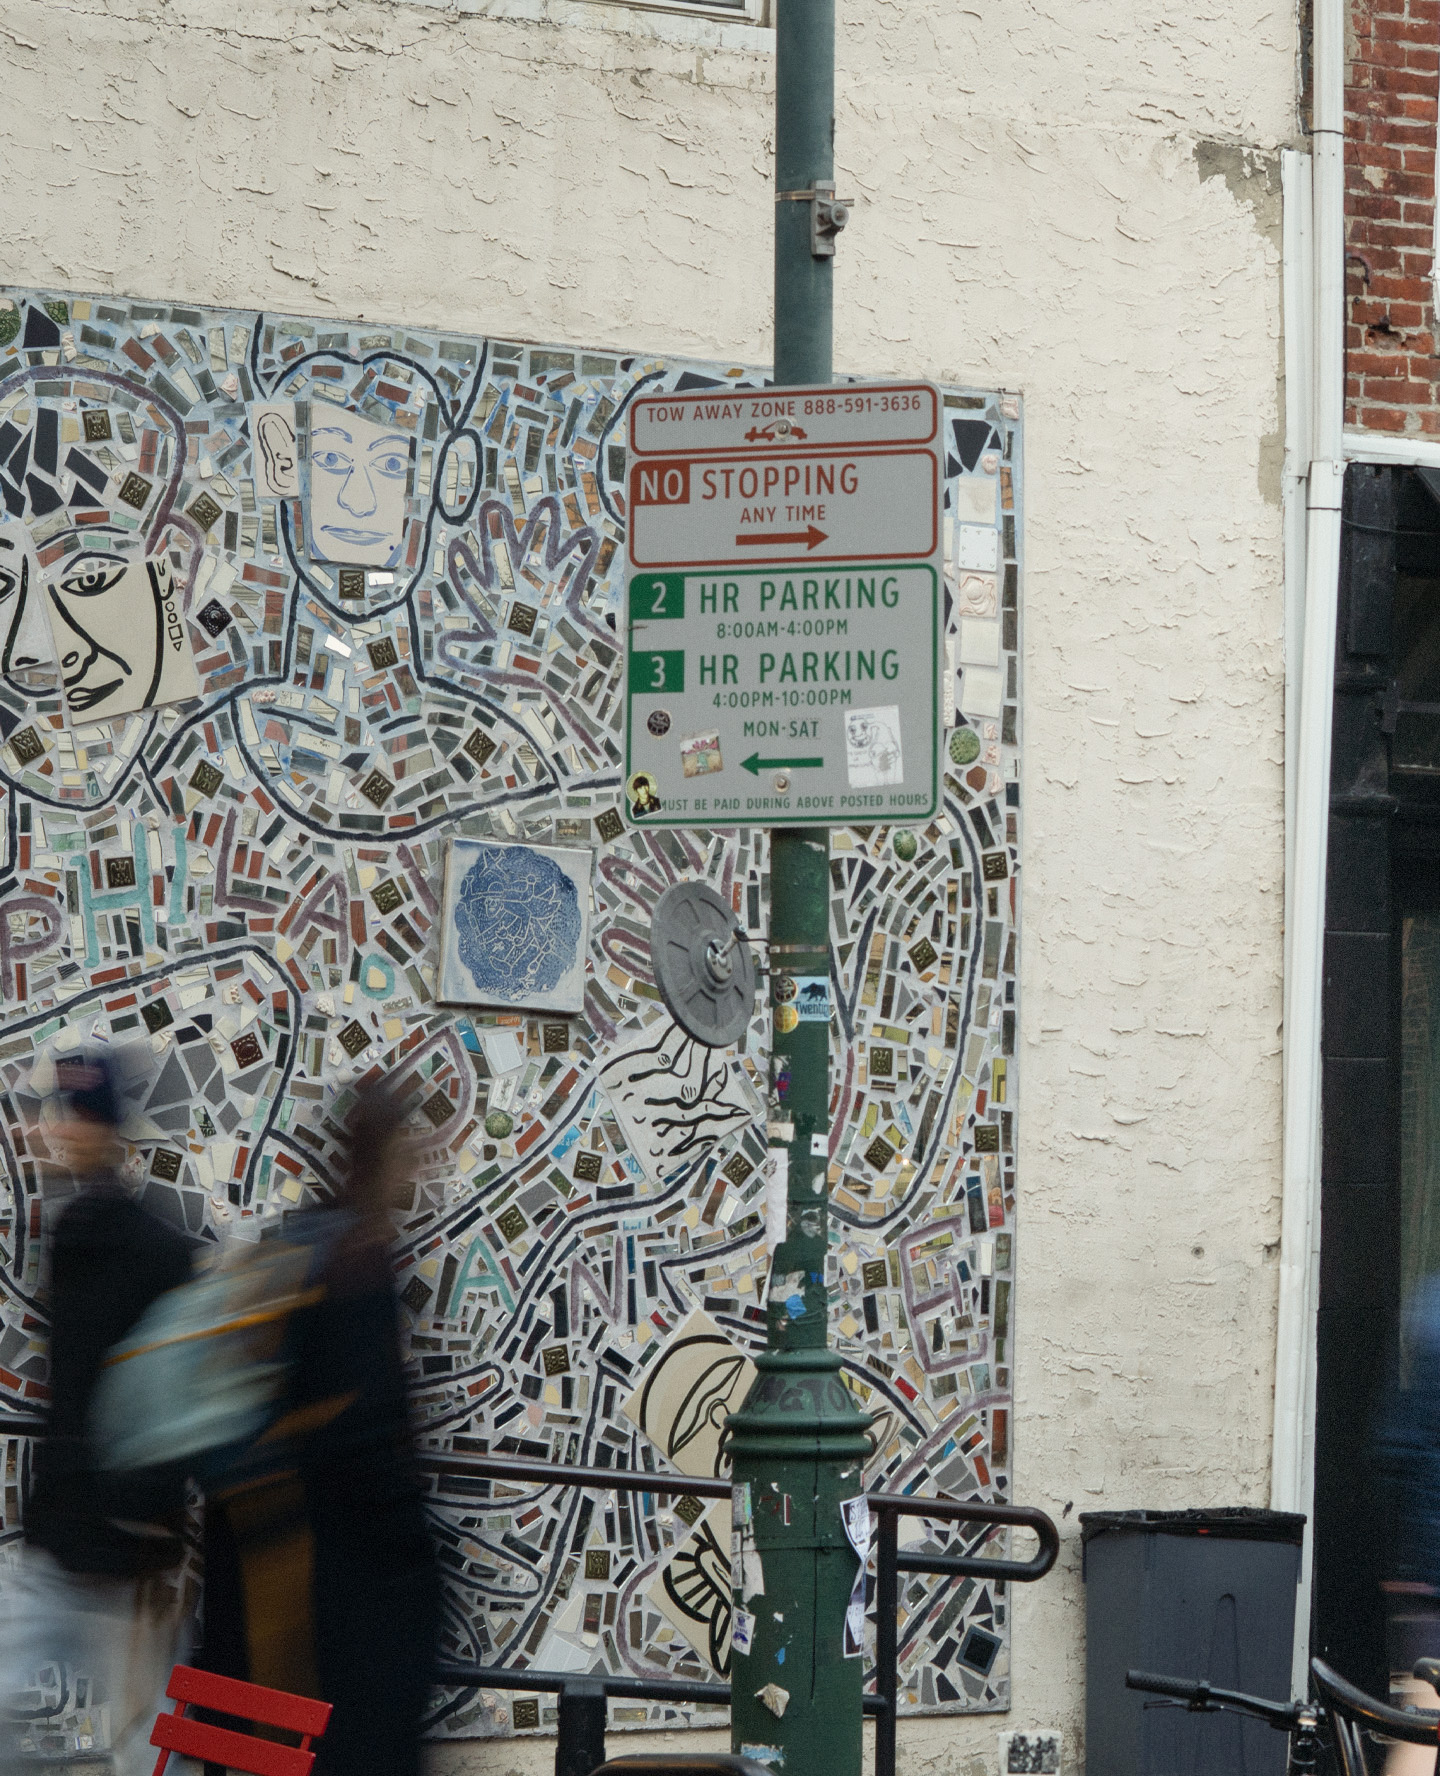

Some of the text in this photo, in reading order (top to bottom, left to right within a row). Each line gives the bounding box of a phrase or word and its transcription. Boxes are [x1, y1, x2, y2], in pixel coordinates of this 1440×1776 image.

[647, 395, 921, 423] TOW AWAY ZONE 888-591-3636
[639, 463, 859, 500] NO STOPPING
[740, 504, 826, 523] ANY TIME
[650, 576, 900, 614] 2 HR PARKING
[716, 619, 848, 639] 8:00AM-4:00PM
[650, 648, 899, 688] 3 HR PARKING
[712, 689, 852, 708] 4:00PM-10:00PM
[743, 720, 819, 738] MON-SAT
[661, 793, 928, 811] MUST BE PAID DURING ABOVE POSTED HOURS
